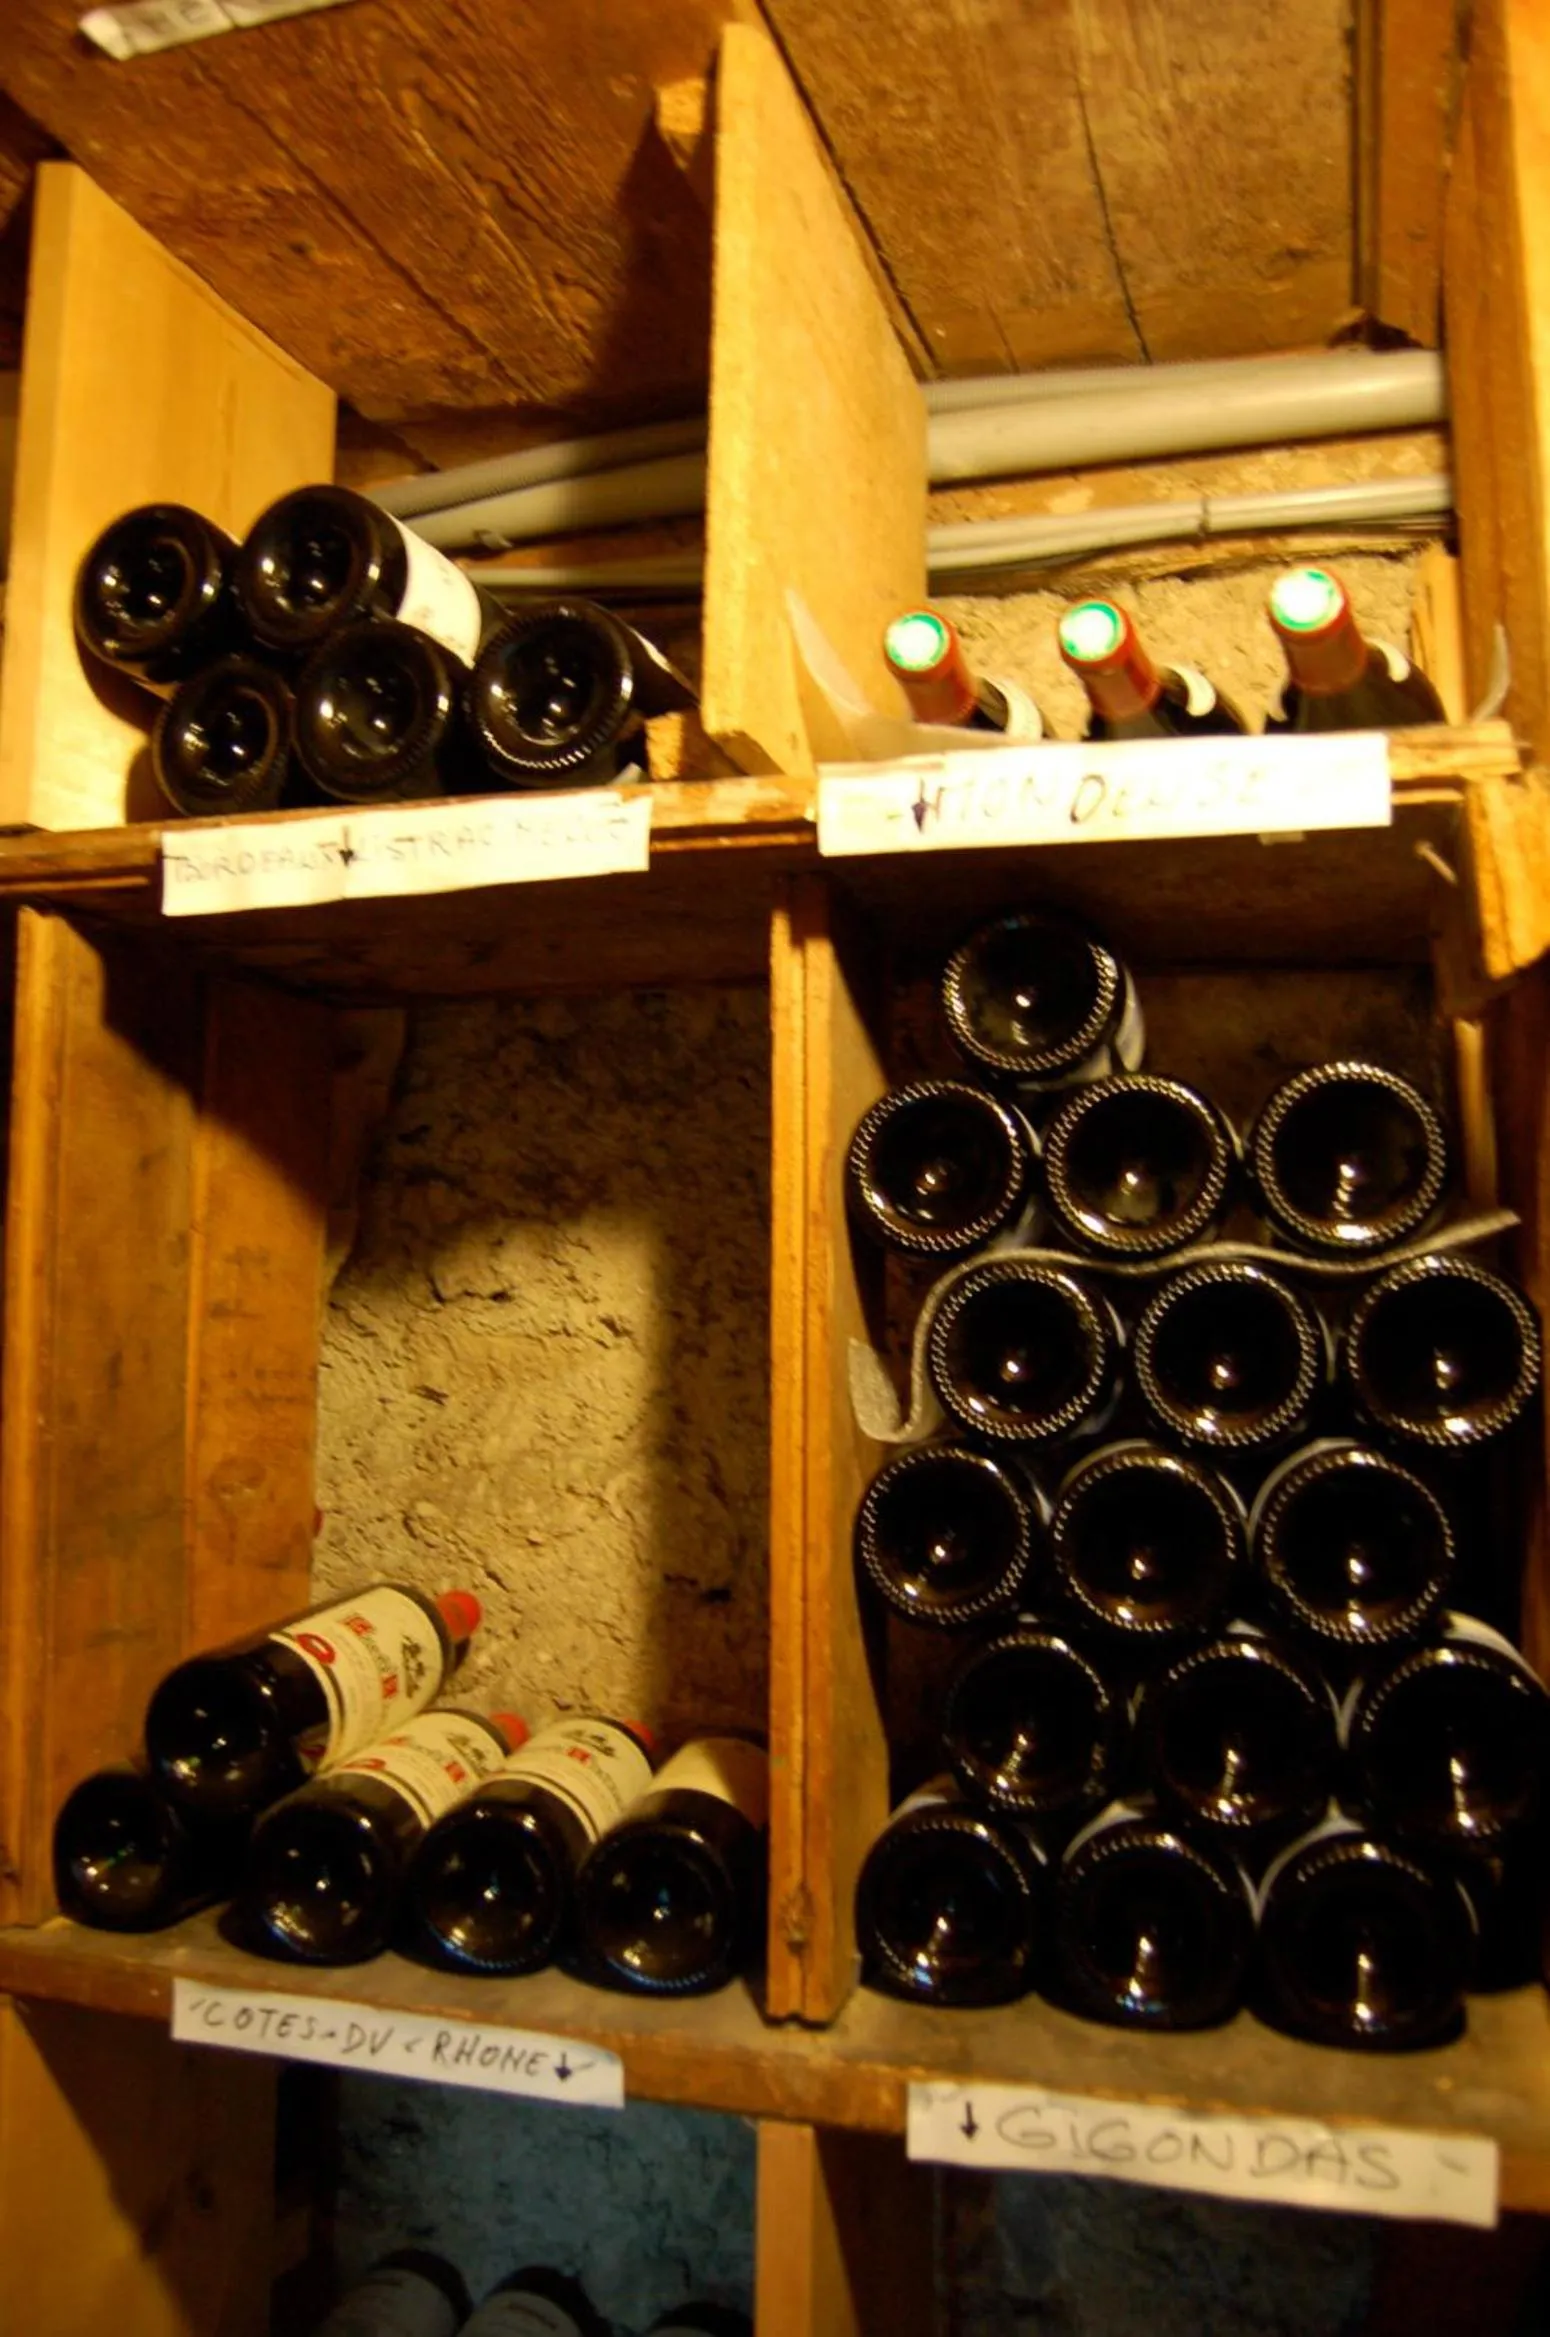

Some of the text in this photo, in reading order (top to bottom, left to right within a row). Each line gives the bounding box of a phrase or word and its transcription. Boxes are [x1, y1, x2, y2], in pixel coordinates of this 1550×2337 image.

[203, 2001, 319, 2040] COTES
[432, 2030, 549, 2077] RHONE
[996, 2105, 1402, 2191] GIGONDAS
